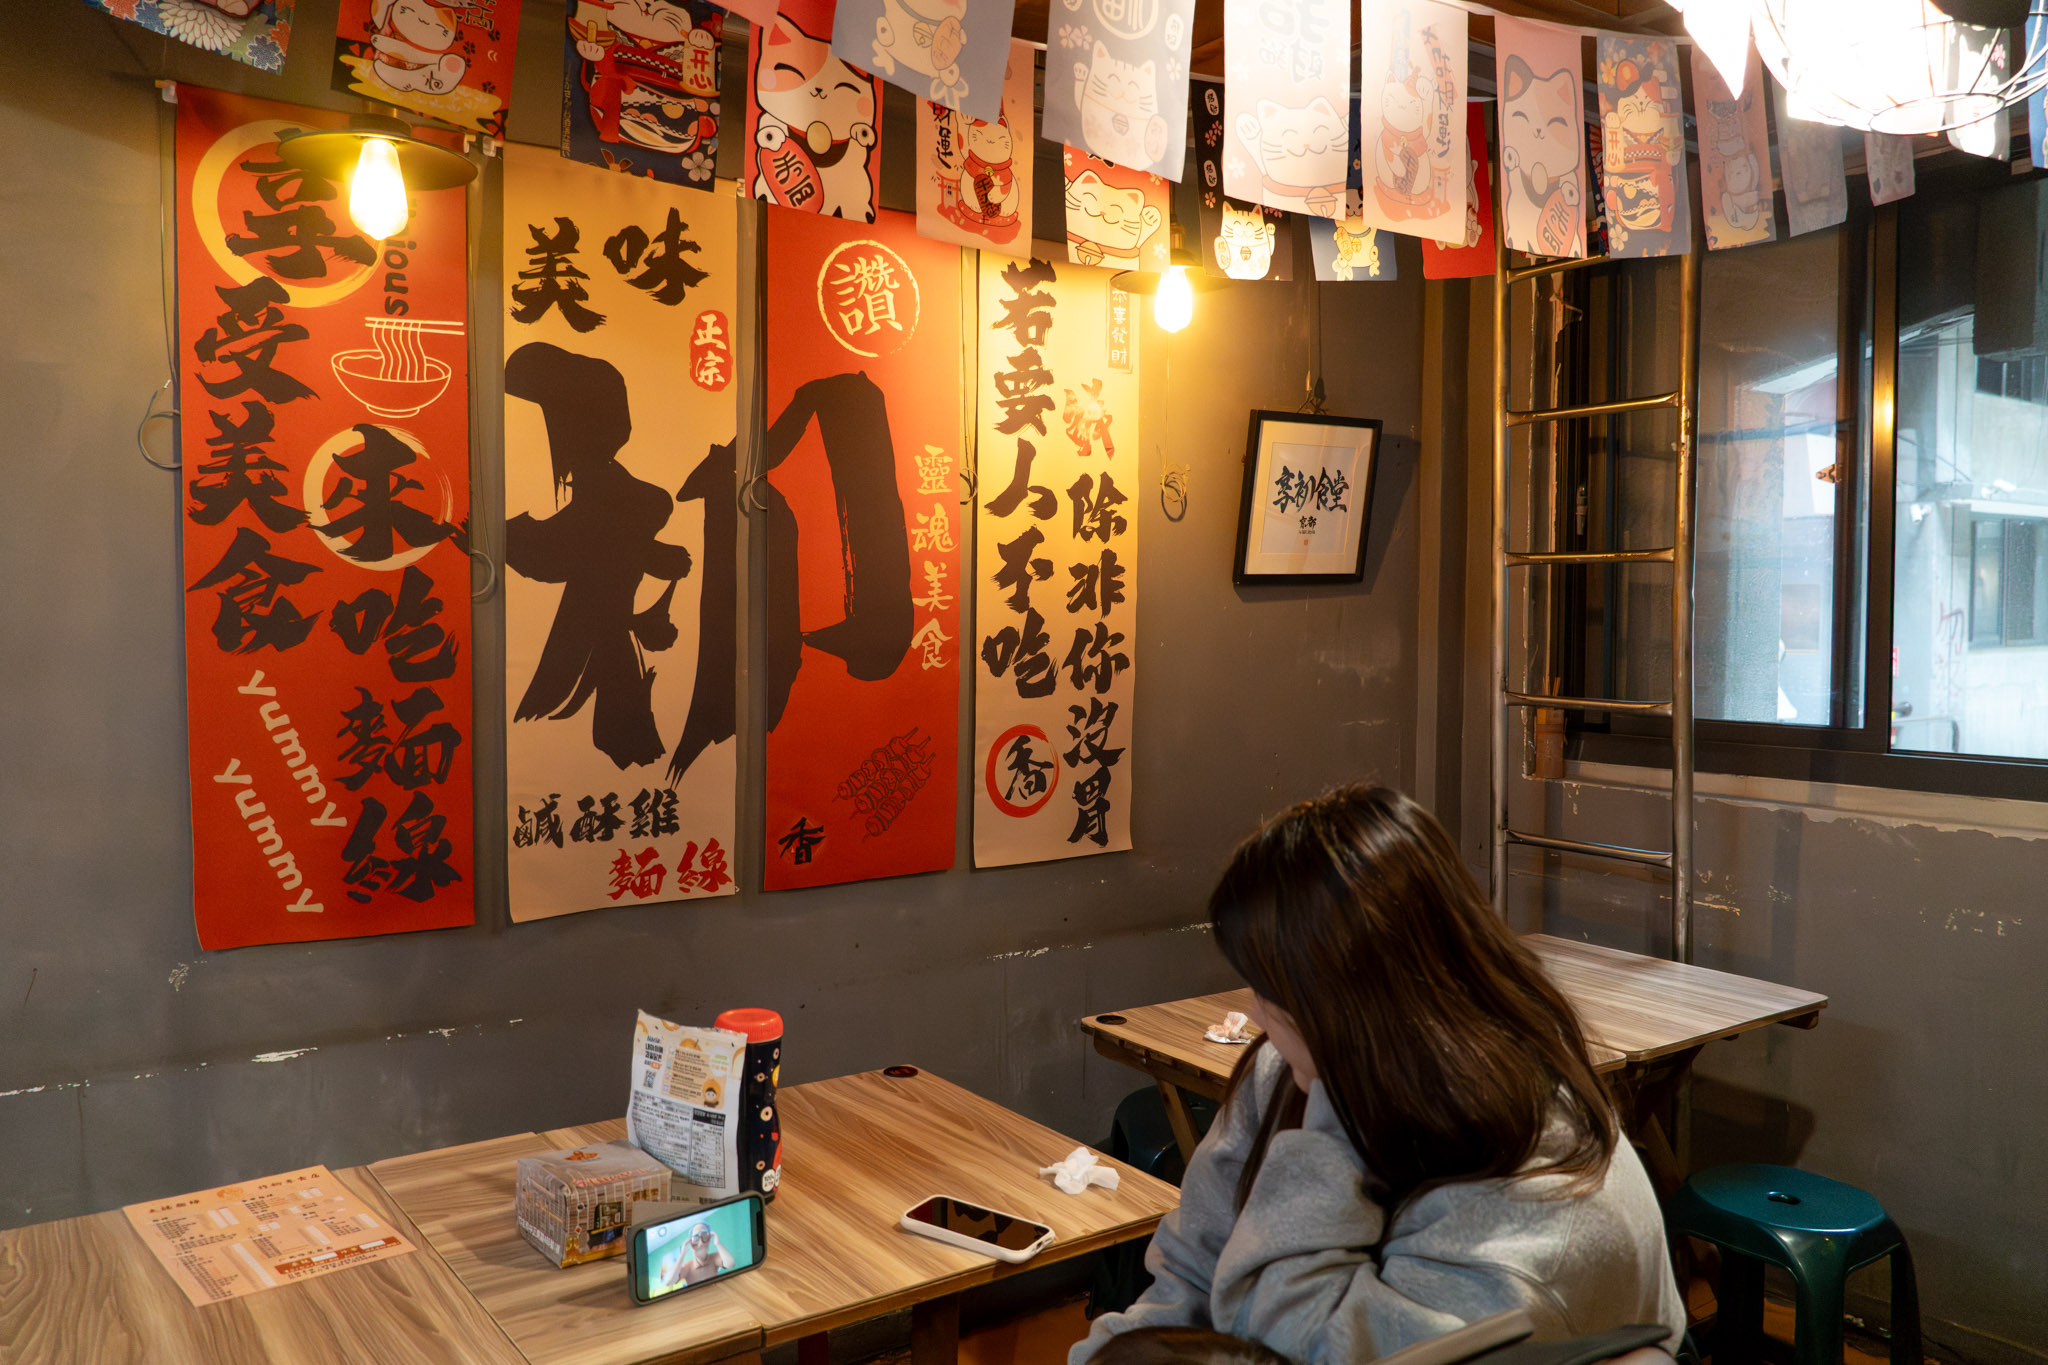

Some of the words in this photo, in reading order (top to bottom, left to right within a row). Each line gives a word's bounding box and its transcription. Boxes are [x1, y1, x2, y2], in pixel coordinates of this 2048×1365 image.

[510, 206, 710, 333] 美味
[829, 254, 903, 336] 讚
[186, 128, 377, 655] 享受美食
[694, 313, 727, 386] 正宗
[982, 257, 1058, 698] 若要人不吃
[912, 445, 957, 671] 靈魂美食
[308, 424, 471, 902] 來吃麵線
[1062, 472, 1130, 847] 除非你沒胃
[237, 670, 347, 827] yummy
[513, 788, 680, 849] 鹹酥雞
[1004, 734, 1055, 801] 香
[213, 759, 324, 914] yummy
[606, 837, 733, 900] 麵線
[778, 818, 828, 866] 香
